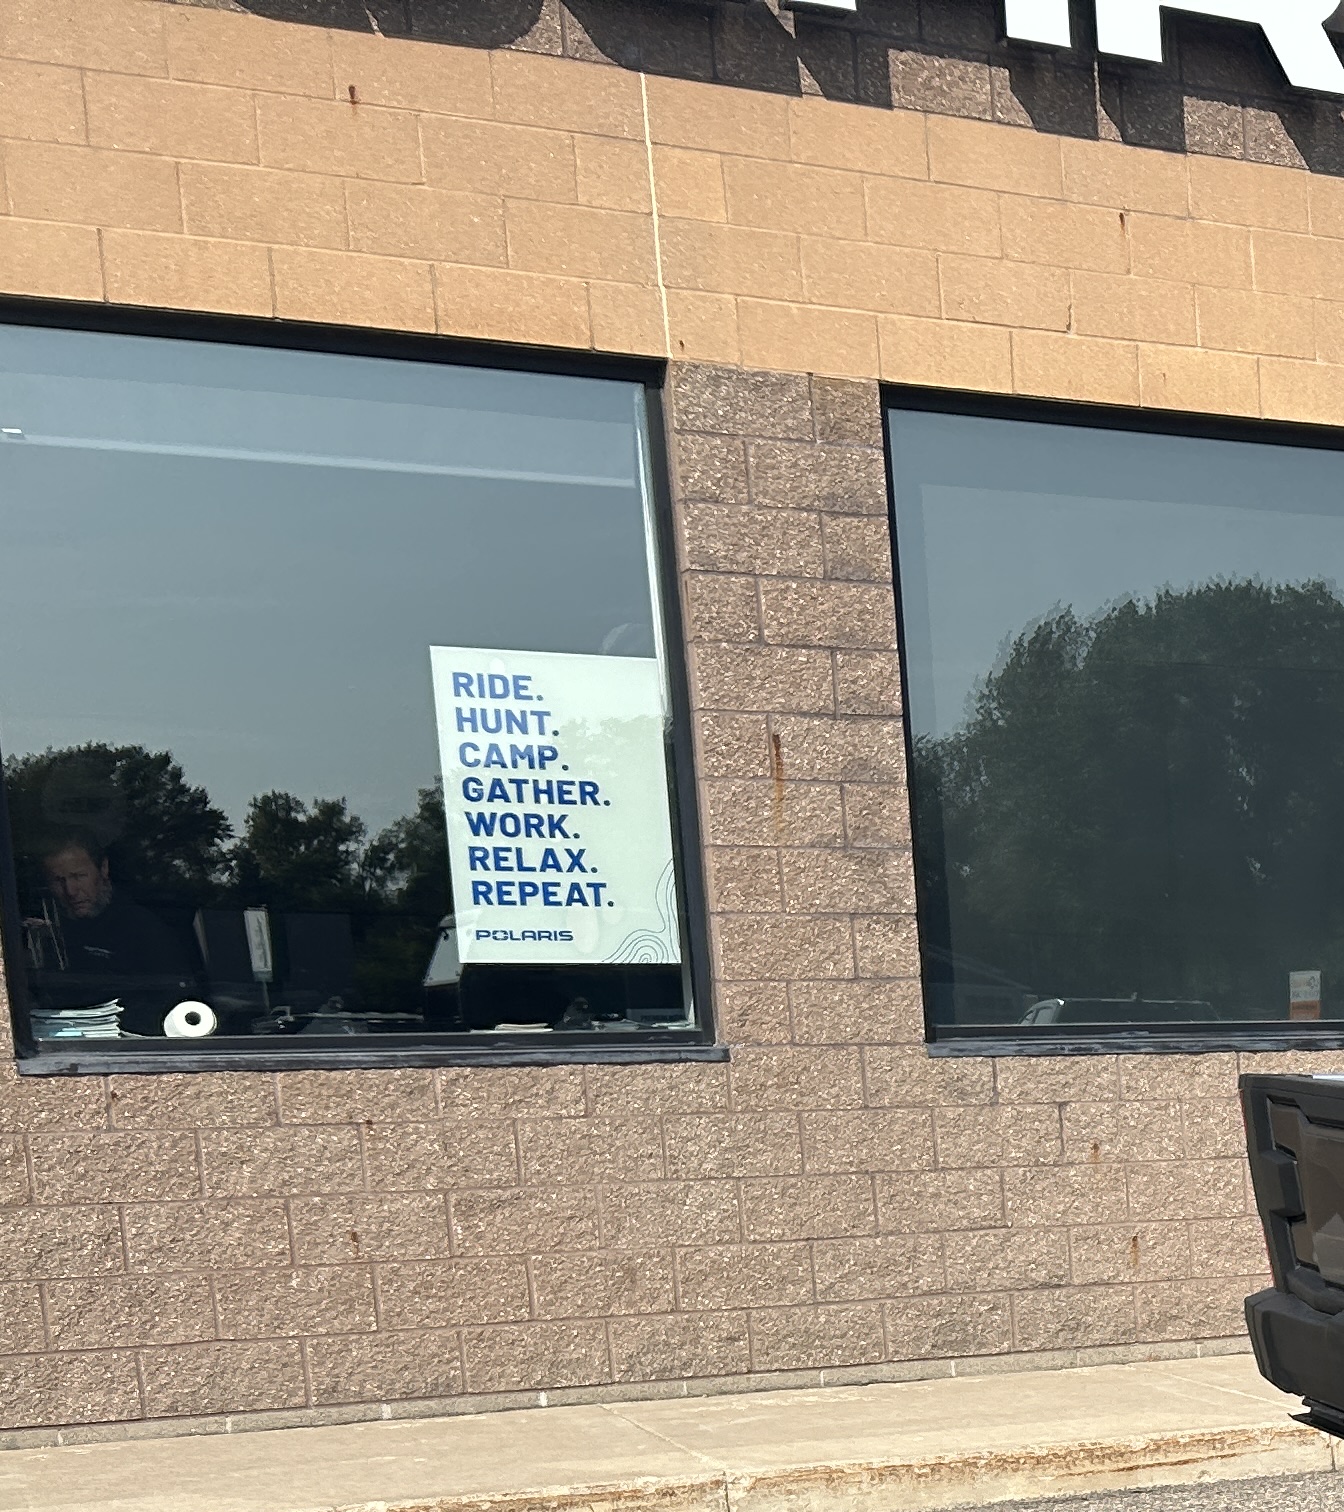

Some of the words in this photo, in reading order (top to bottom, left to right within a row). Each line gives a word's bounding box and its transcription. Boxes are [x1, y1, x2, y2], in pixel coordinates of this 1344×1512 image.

[452, 672, 543, 701] RIDE.
[455, 707, 560, 736] HUNT.
[459, 742, 569, 771] CAMP.
[462, 777, 611, 807] GATHER.
[464, 812, 581, 839] WORK.
[468, 846, 598, 874] RELAX.
[471, 880, 615, 908] REPEAT.
[476, 929, 574, 941] POLARIS
